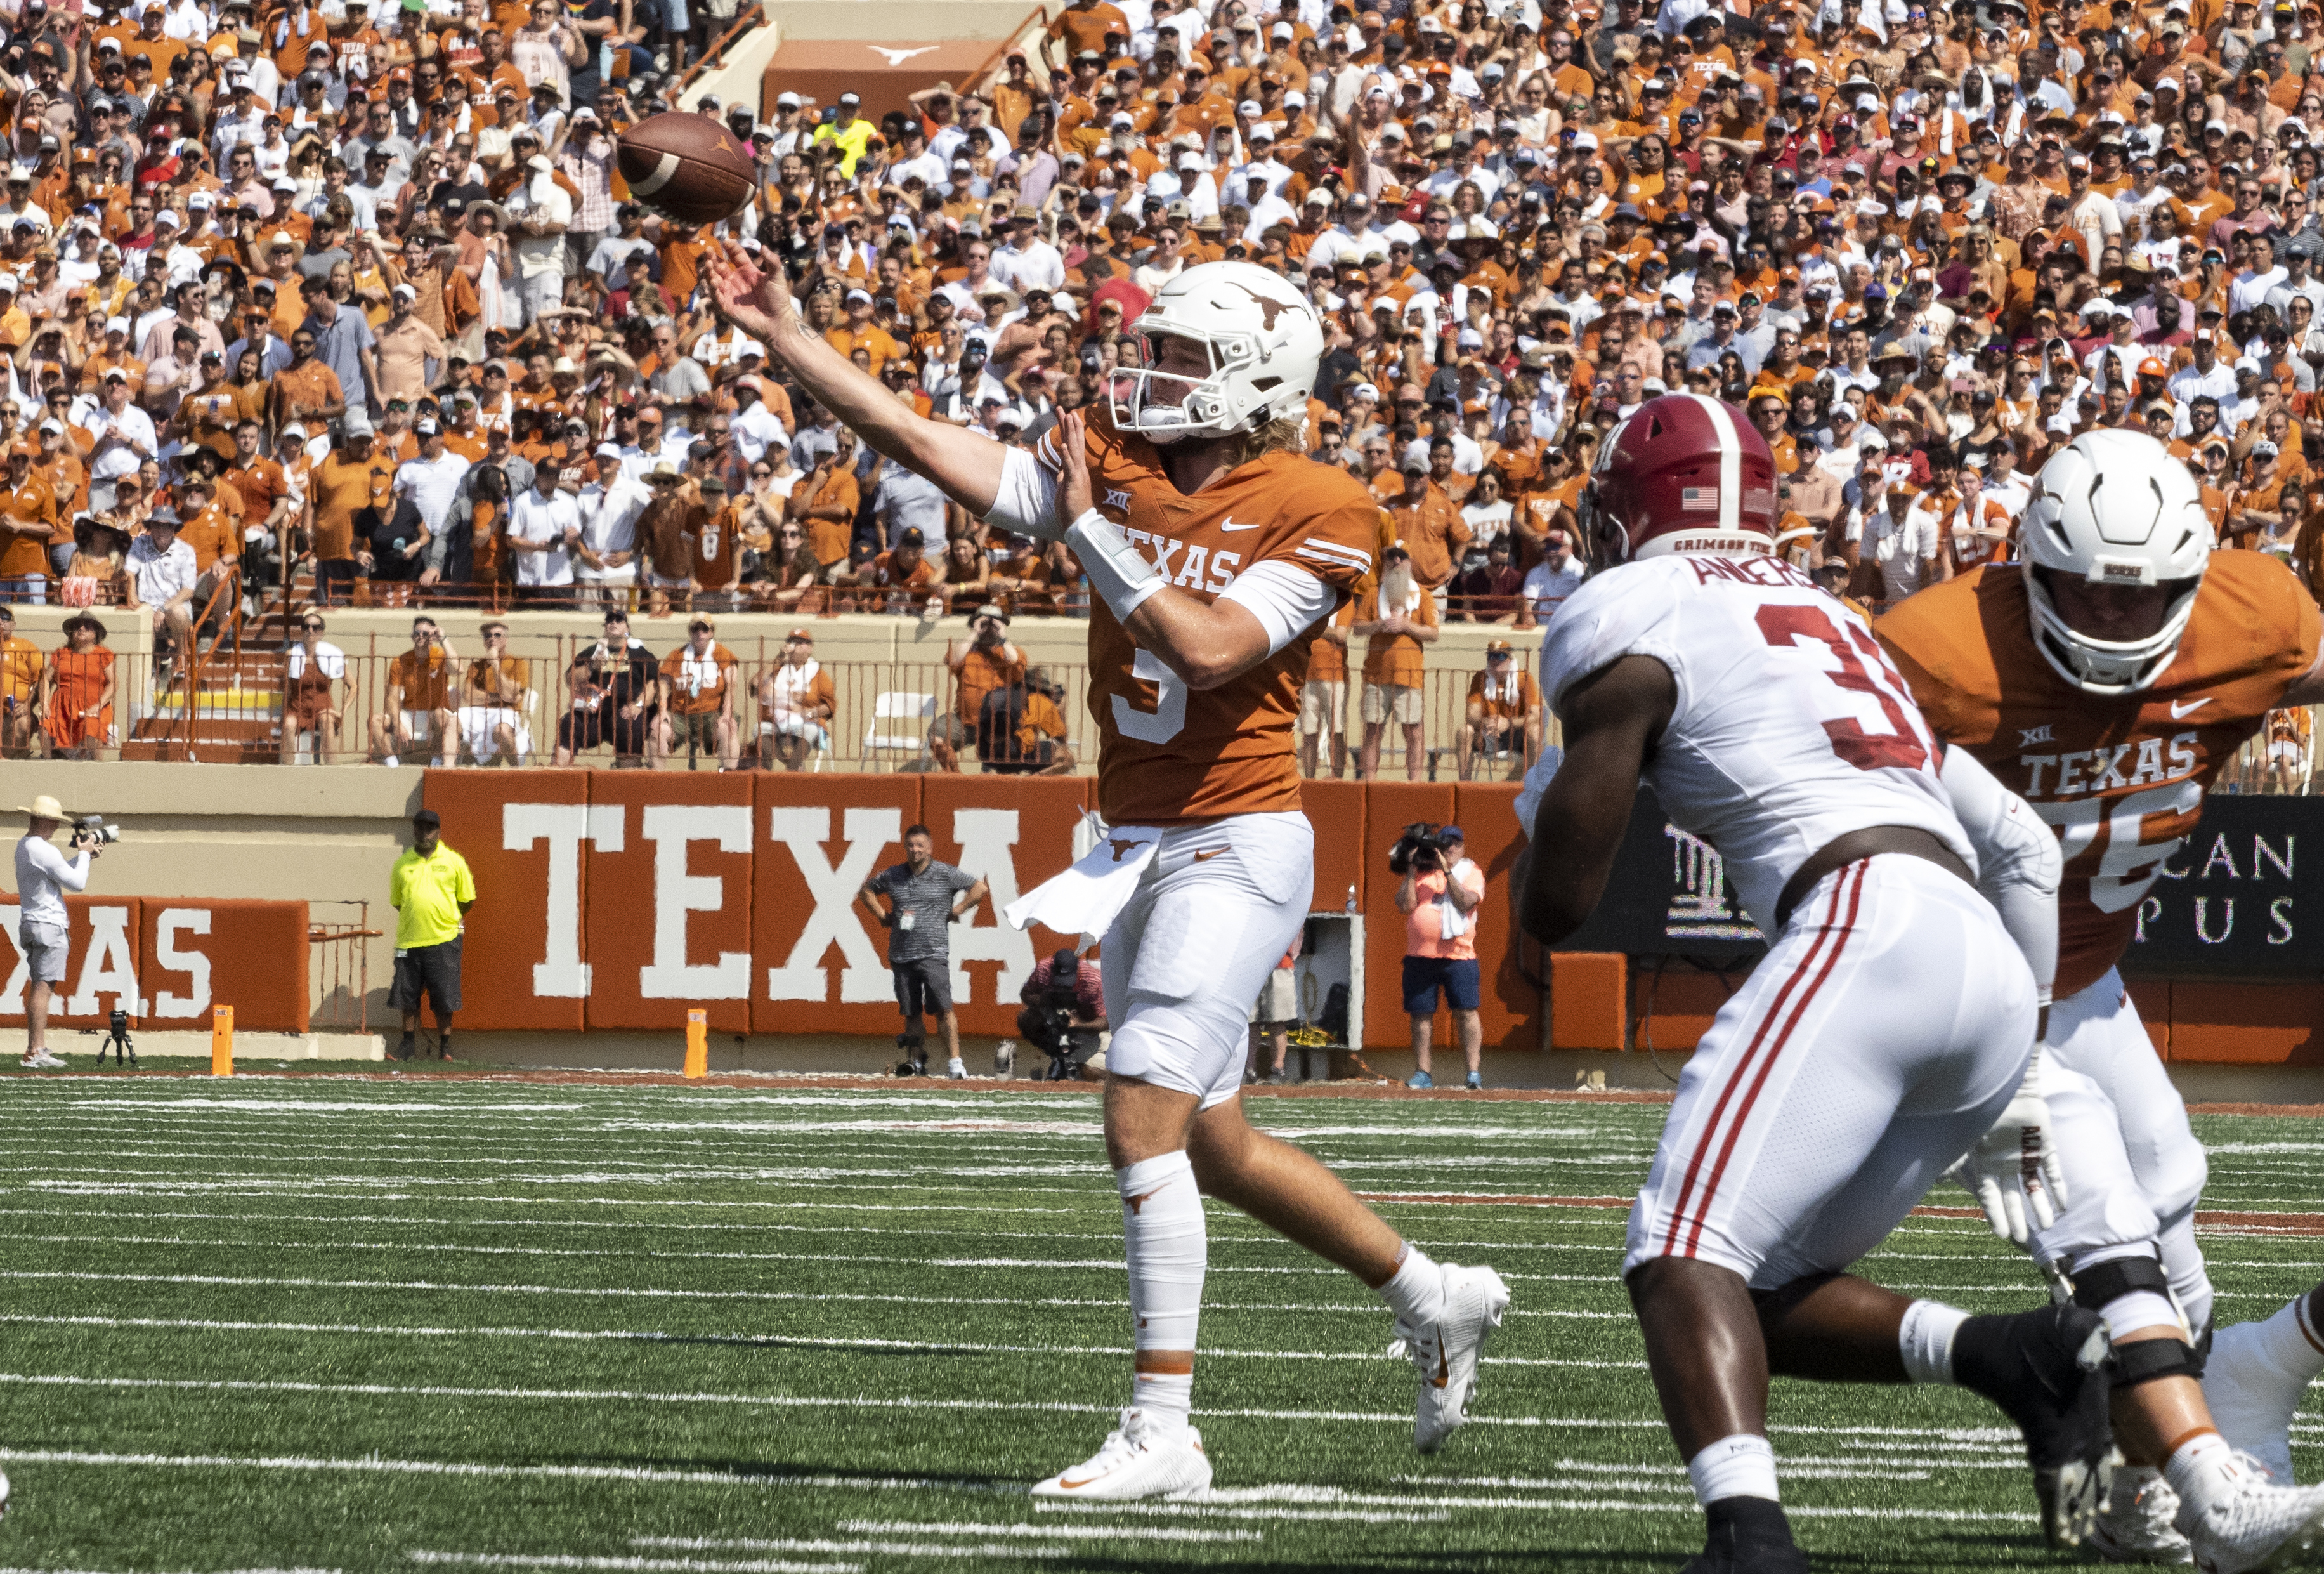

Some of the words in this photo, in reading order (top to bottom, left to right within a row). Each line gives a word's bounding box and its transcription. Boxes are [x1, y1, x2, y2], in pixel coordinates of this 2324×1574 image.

[471, 93, 497, 105] TEXA
[1674, 539, 1746, 551] CRIMSON
[2020, 731, 2198, 797] TEXAS
[503, 803, 1109, 1004] TEXA
